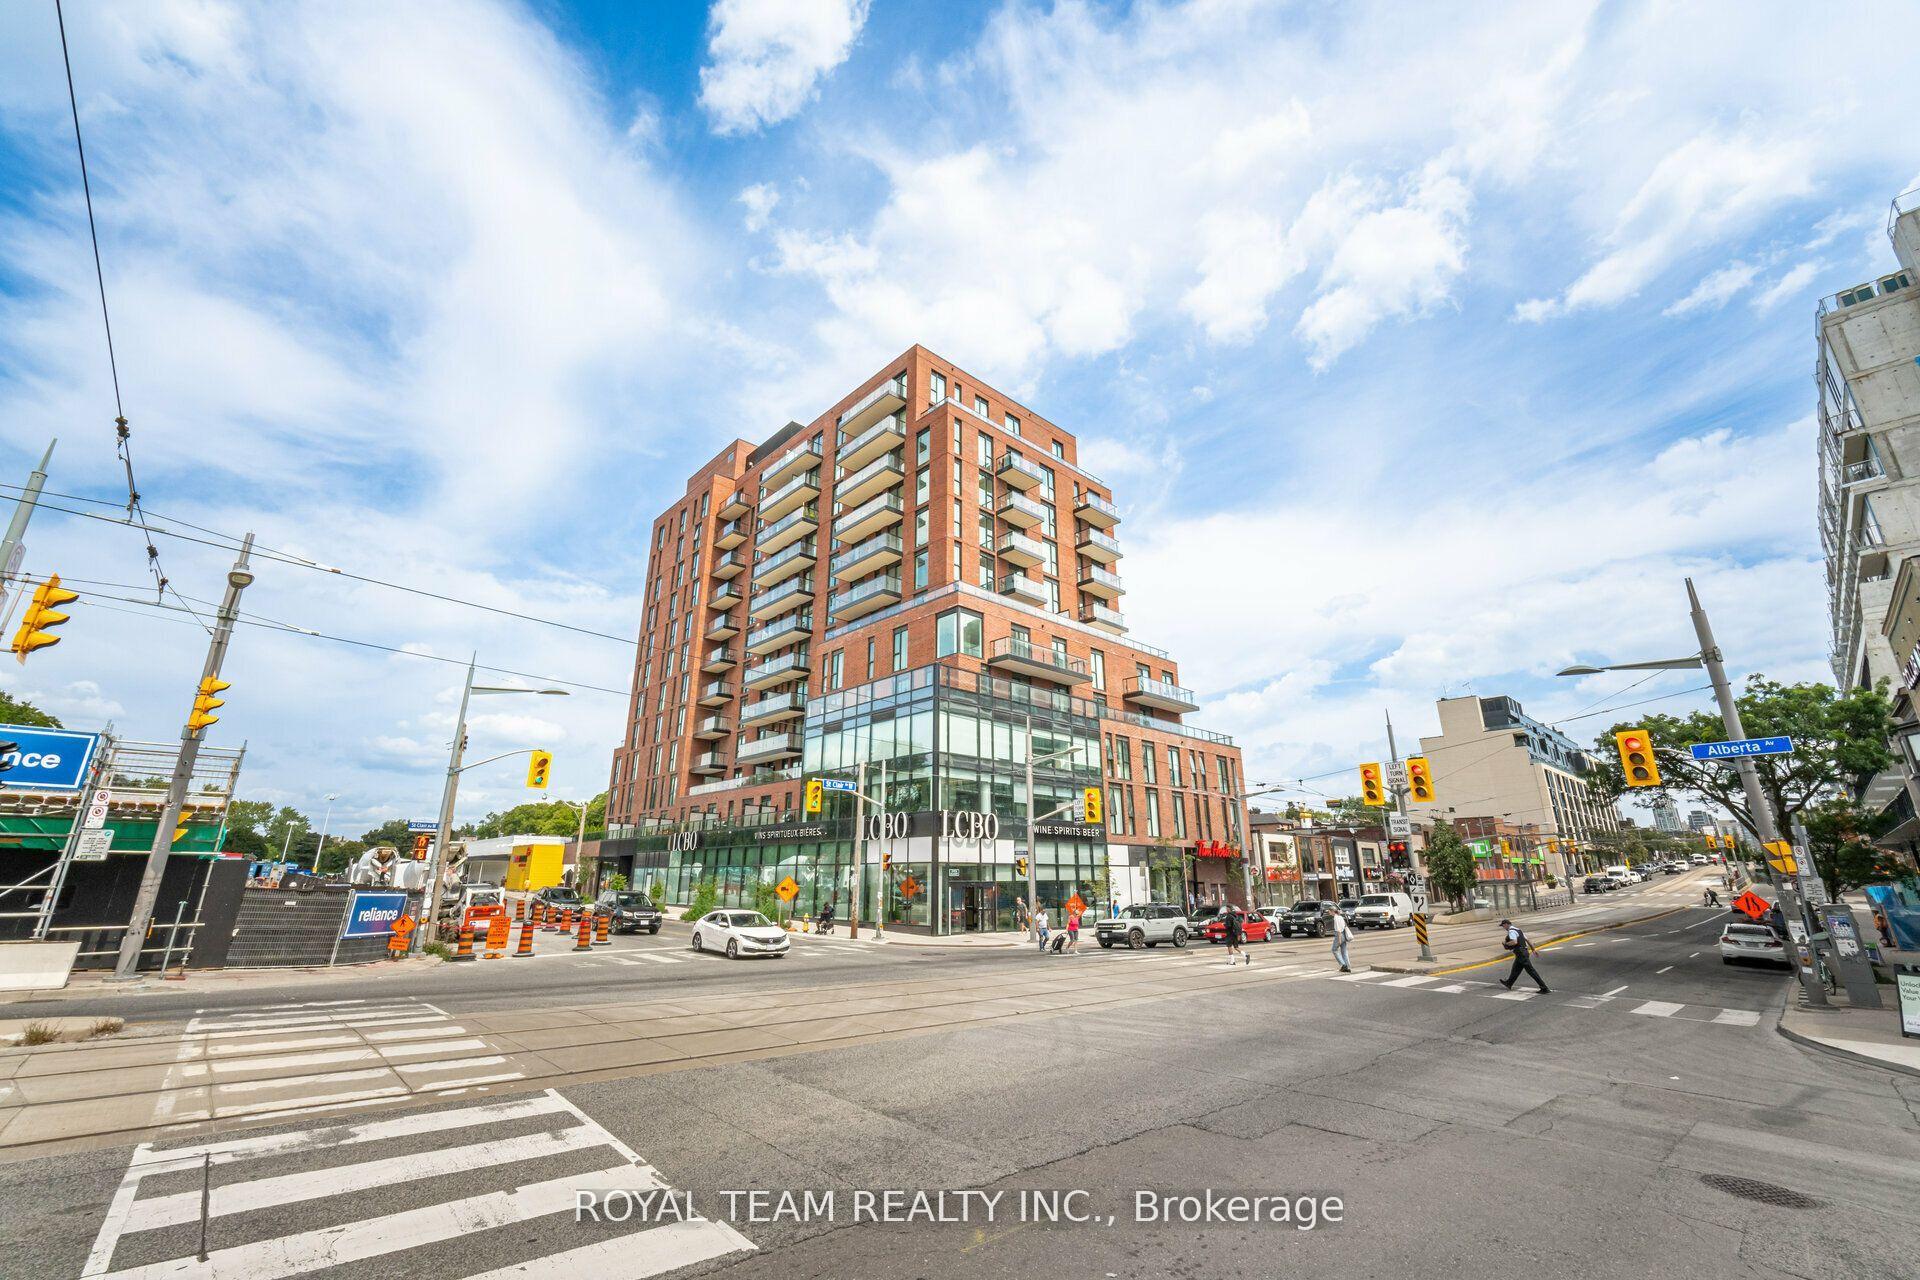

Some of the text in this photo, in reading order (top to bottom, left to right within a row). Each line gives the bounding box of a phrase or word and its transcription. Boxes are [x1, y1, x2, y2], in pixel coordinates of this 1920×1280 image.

[1708, 742, 1760, 756] Alberta
[862, 811, 908, 840] LCBO
[942, 809, 999, 840] LCBO
[1033, 826, 1100, 837] WINE SPIRITS BEER
[673, 831, 698, 851] LCBO
[767, 829, 799, 839] SPIRITUEUX
[358, 907, 398, 922] reliance
[1901, 987, 1919, 995] Value
